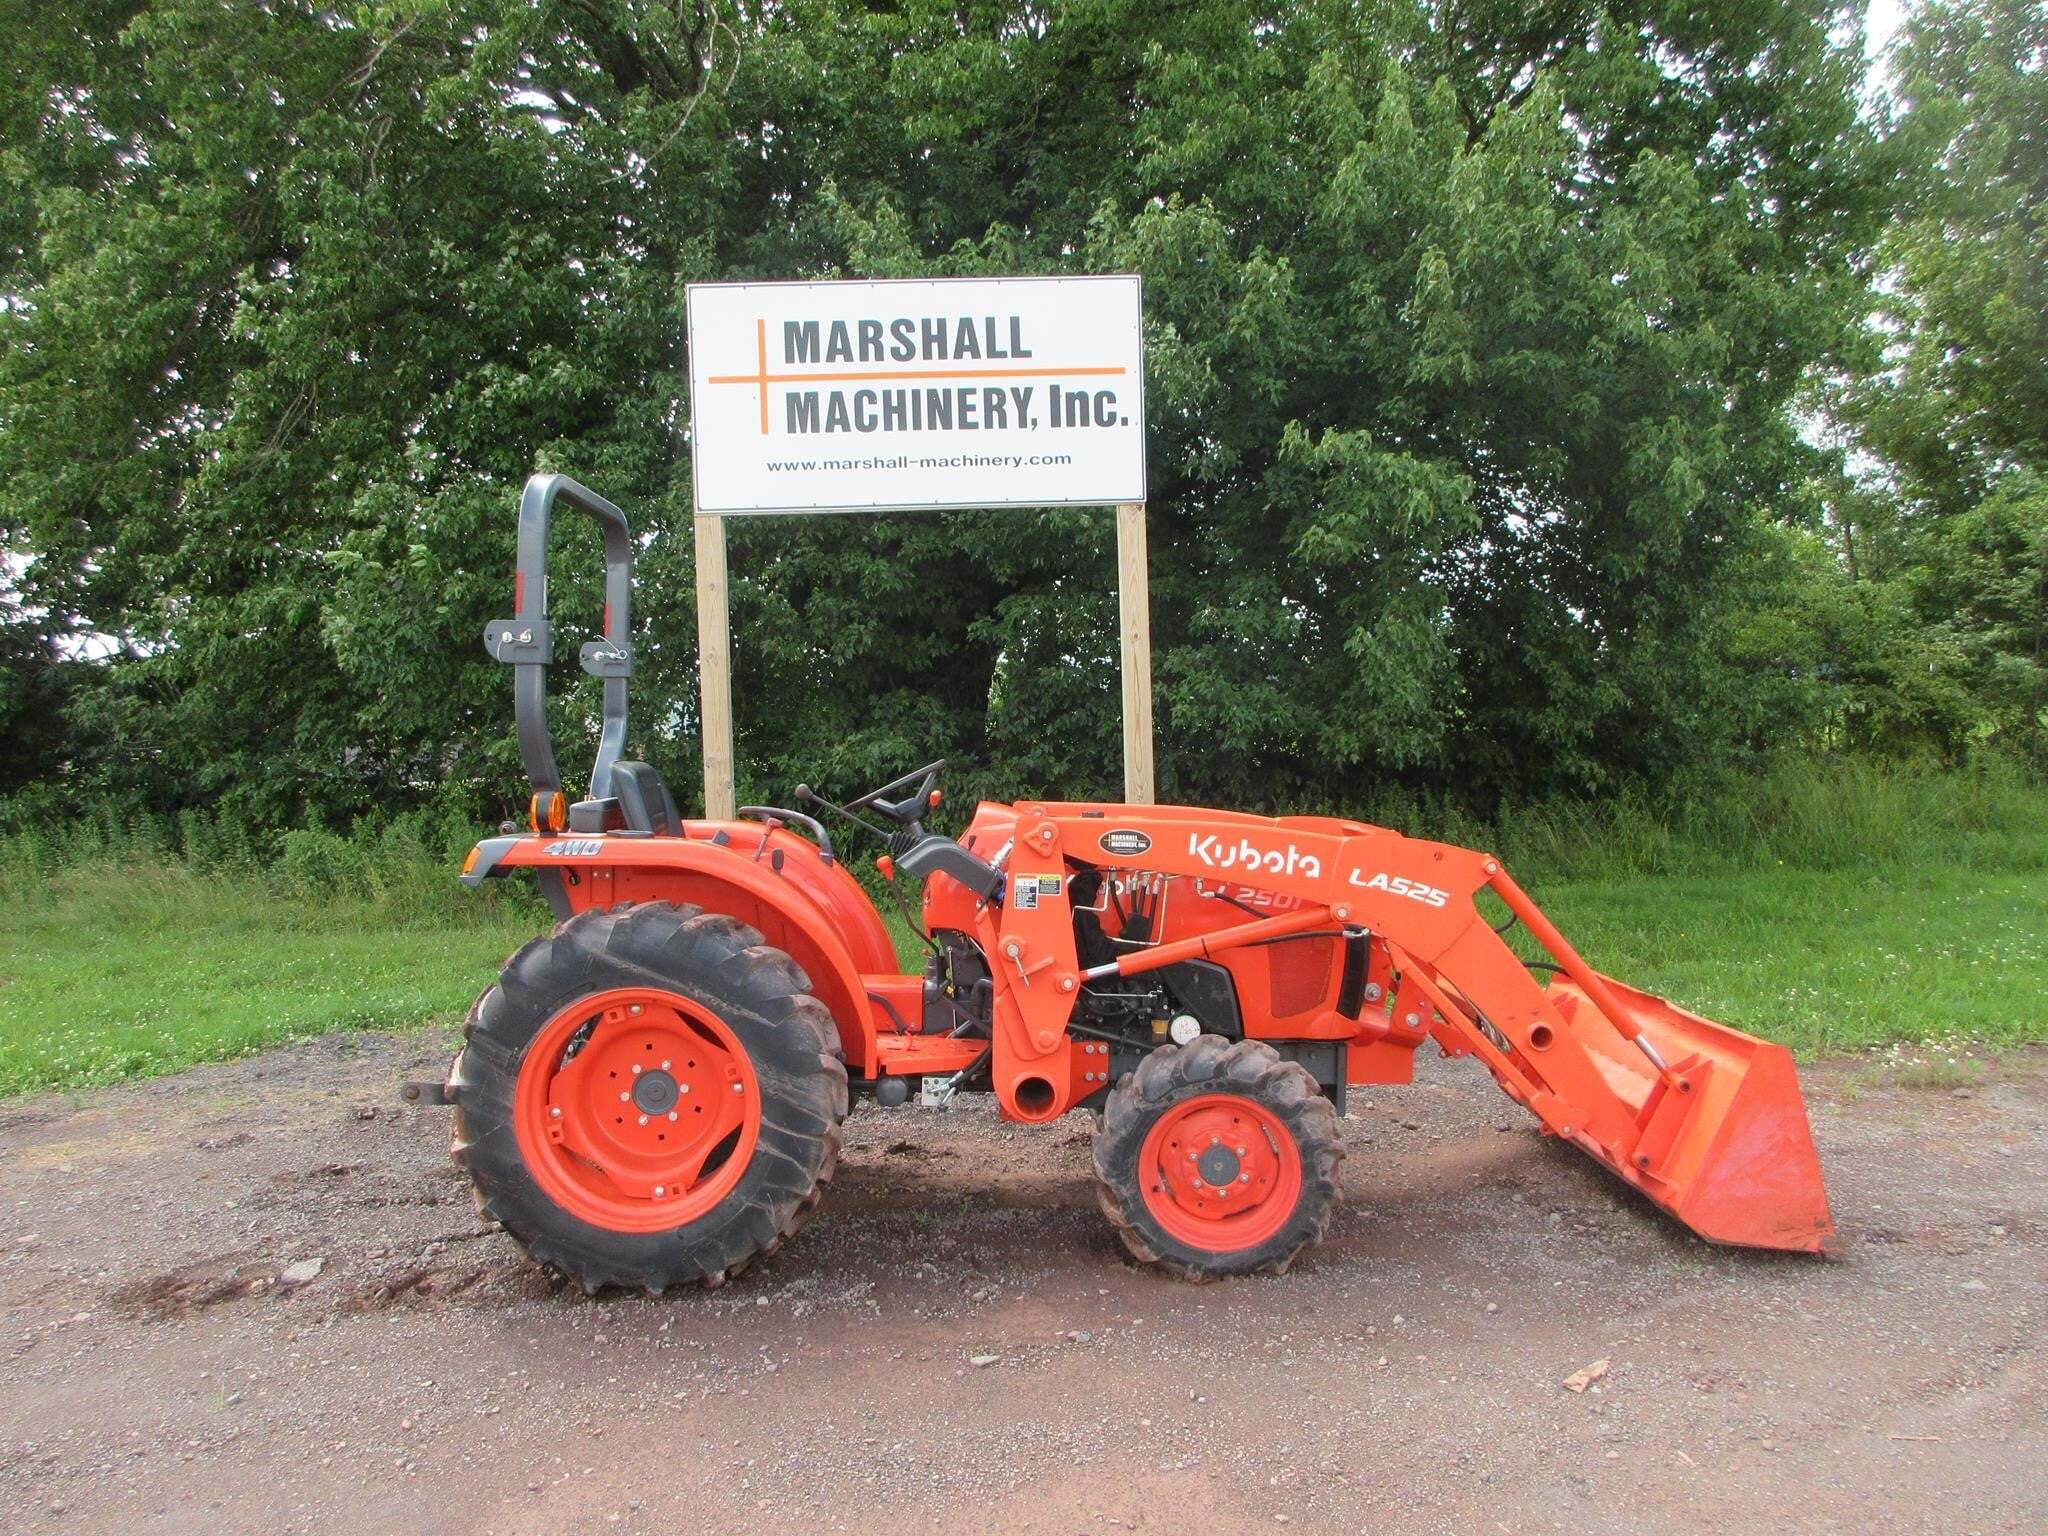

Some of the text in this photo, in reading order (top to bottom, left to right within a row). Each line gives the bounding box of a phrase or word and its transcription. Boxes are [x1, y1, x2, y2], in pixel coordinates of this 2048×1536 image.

[783, 316, 1032, 364] MARSHALL
[786, 384, 1129, 434] MACHINERY, Inc.
[766, 453, 1072, 472] www.marshall-machinery.com
[542, 841, 604, 856] 4WD
[1188, 832, 1321, 879] Kubota
[1349, 868, 1450, 908] LA525
